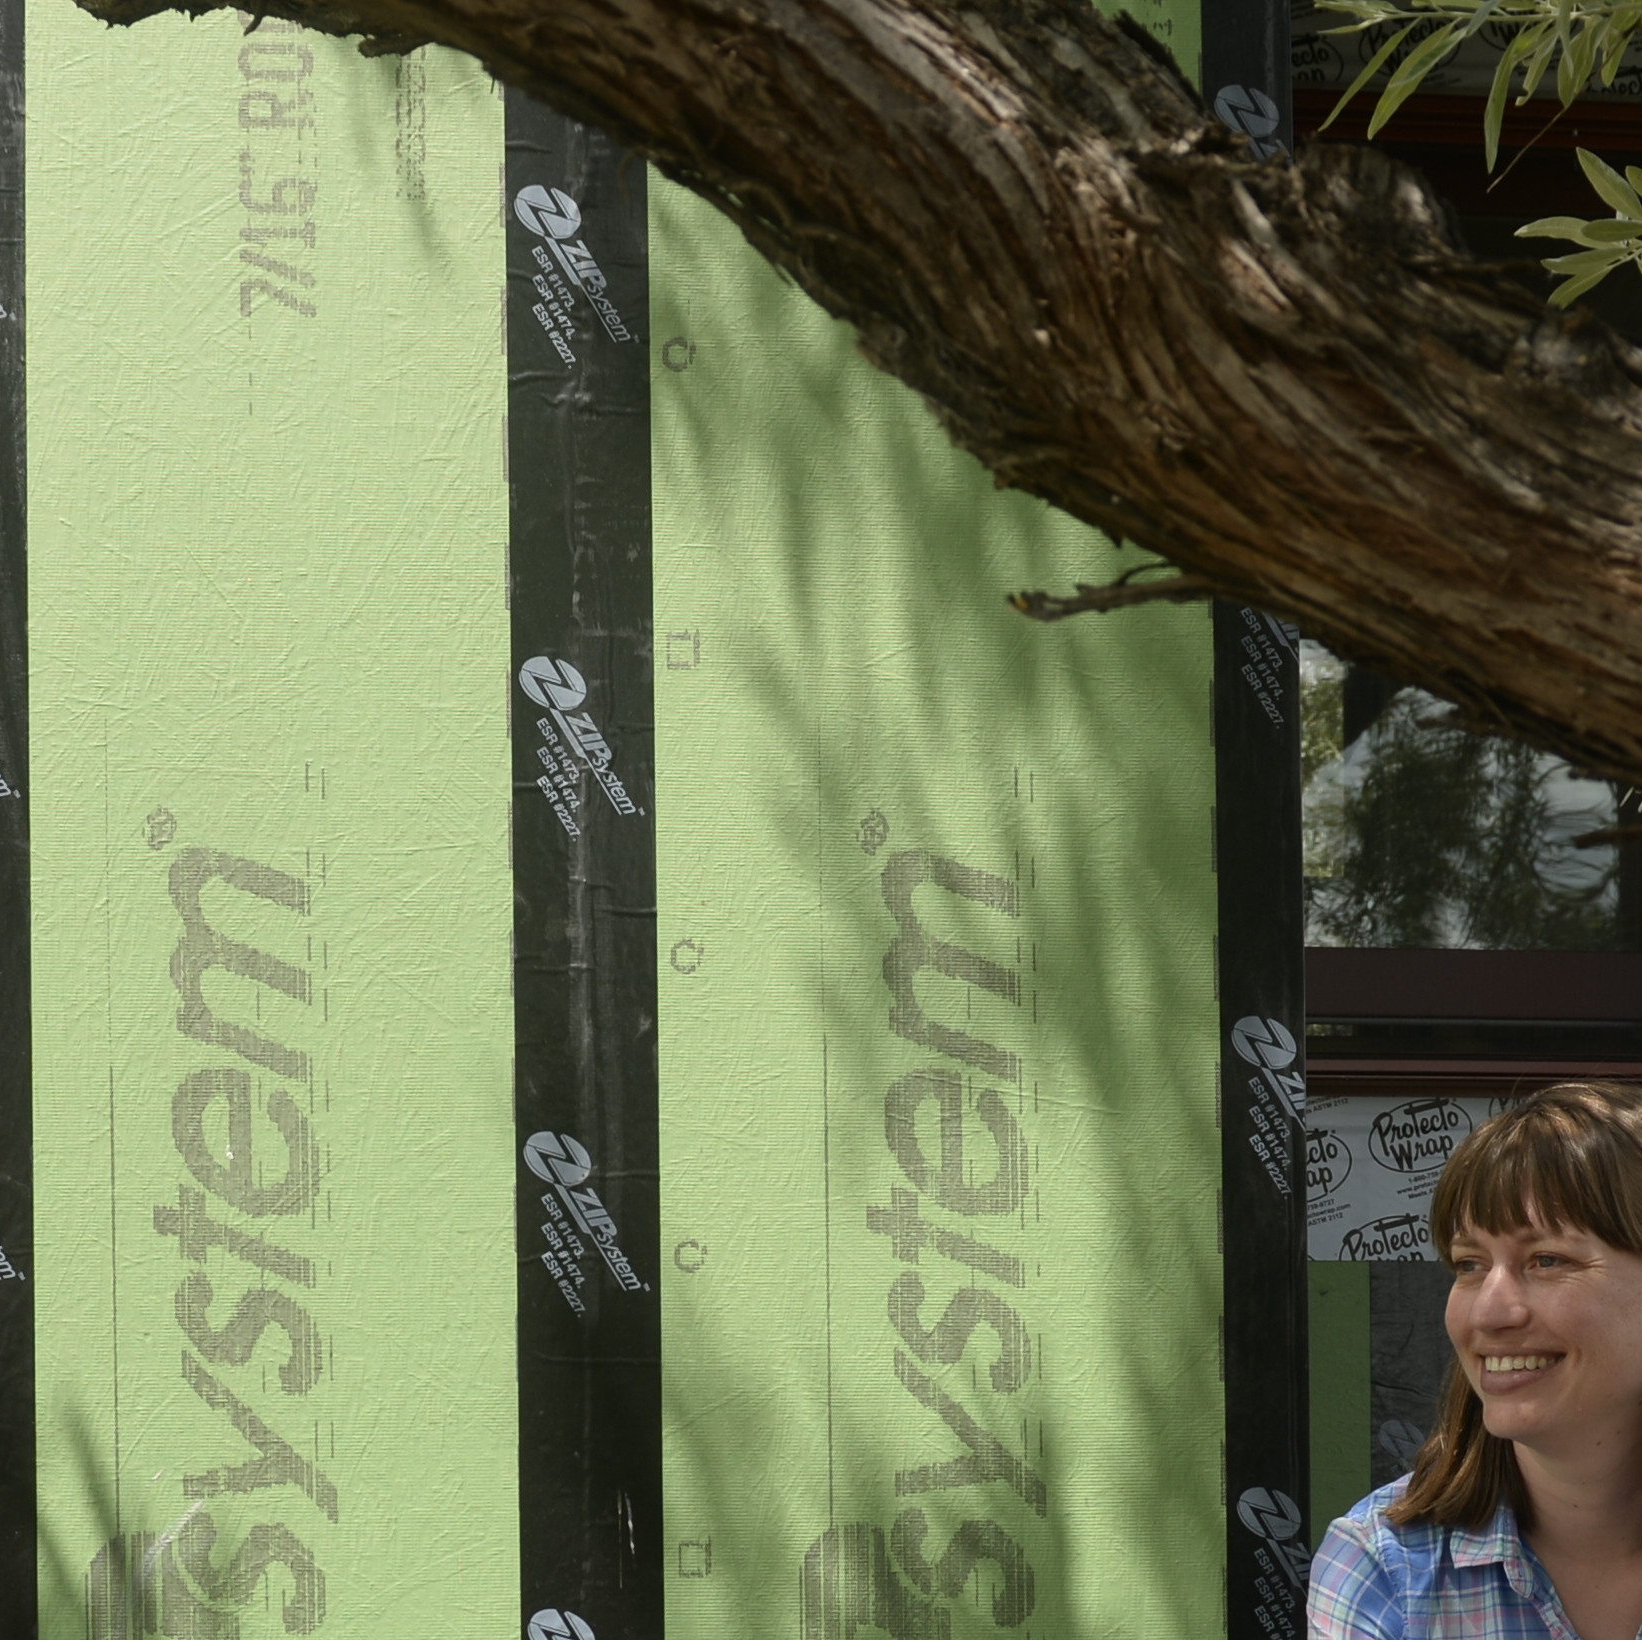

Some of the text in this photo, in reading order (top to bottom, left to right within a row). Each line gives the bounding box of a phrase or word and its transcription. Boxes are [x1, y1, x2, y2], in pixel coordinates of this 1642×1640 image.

[535, 717, 580, 785] ESR #1473.
[535, 747, 581, 814] ESR #1474.
[535, 775, 582, 843] ESR #2227.
[1248, 1077, 1270, 1104] ESR
[1248, 1105, 1271, 1132] ESR
[1249, 1134, 1271, 1160] ESR
